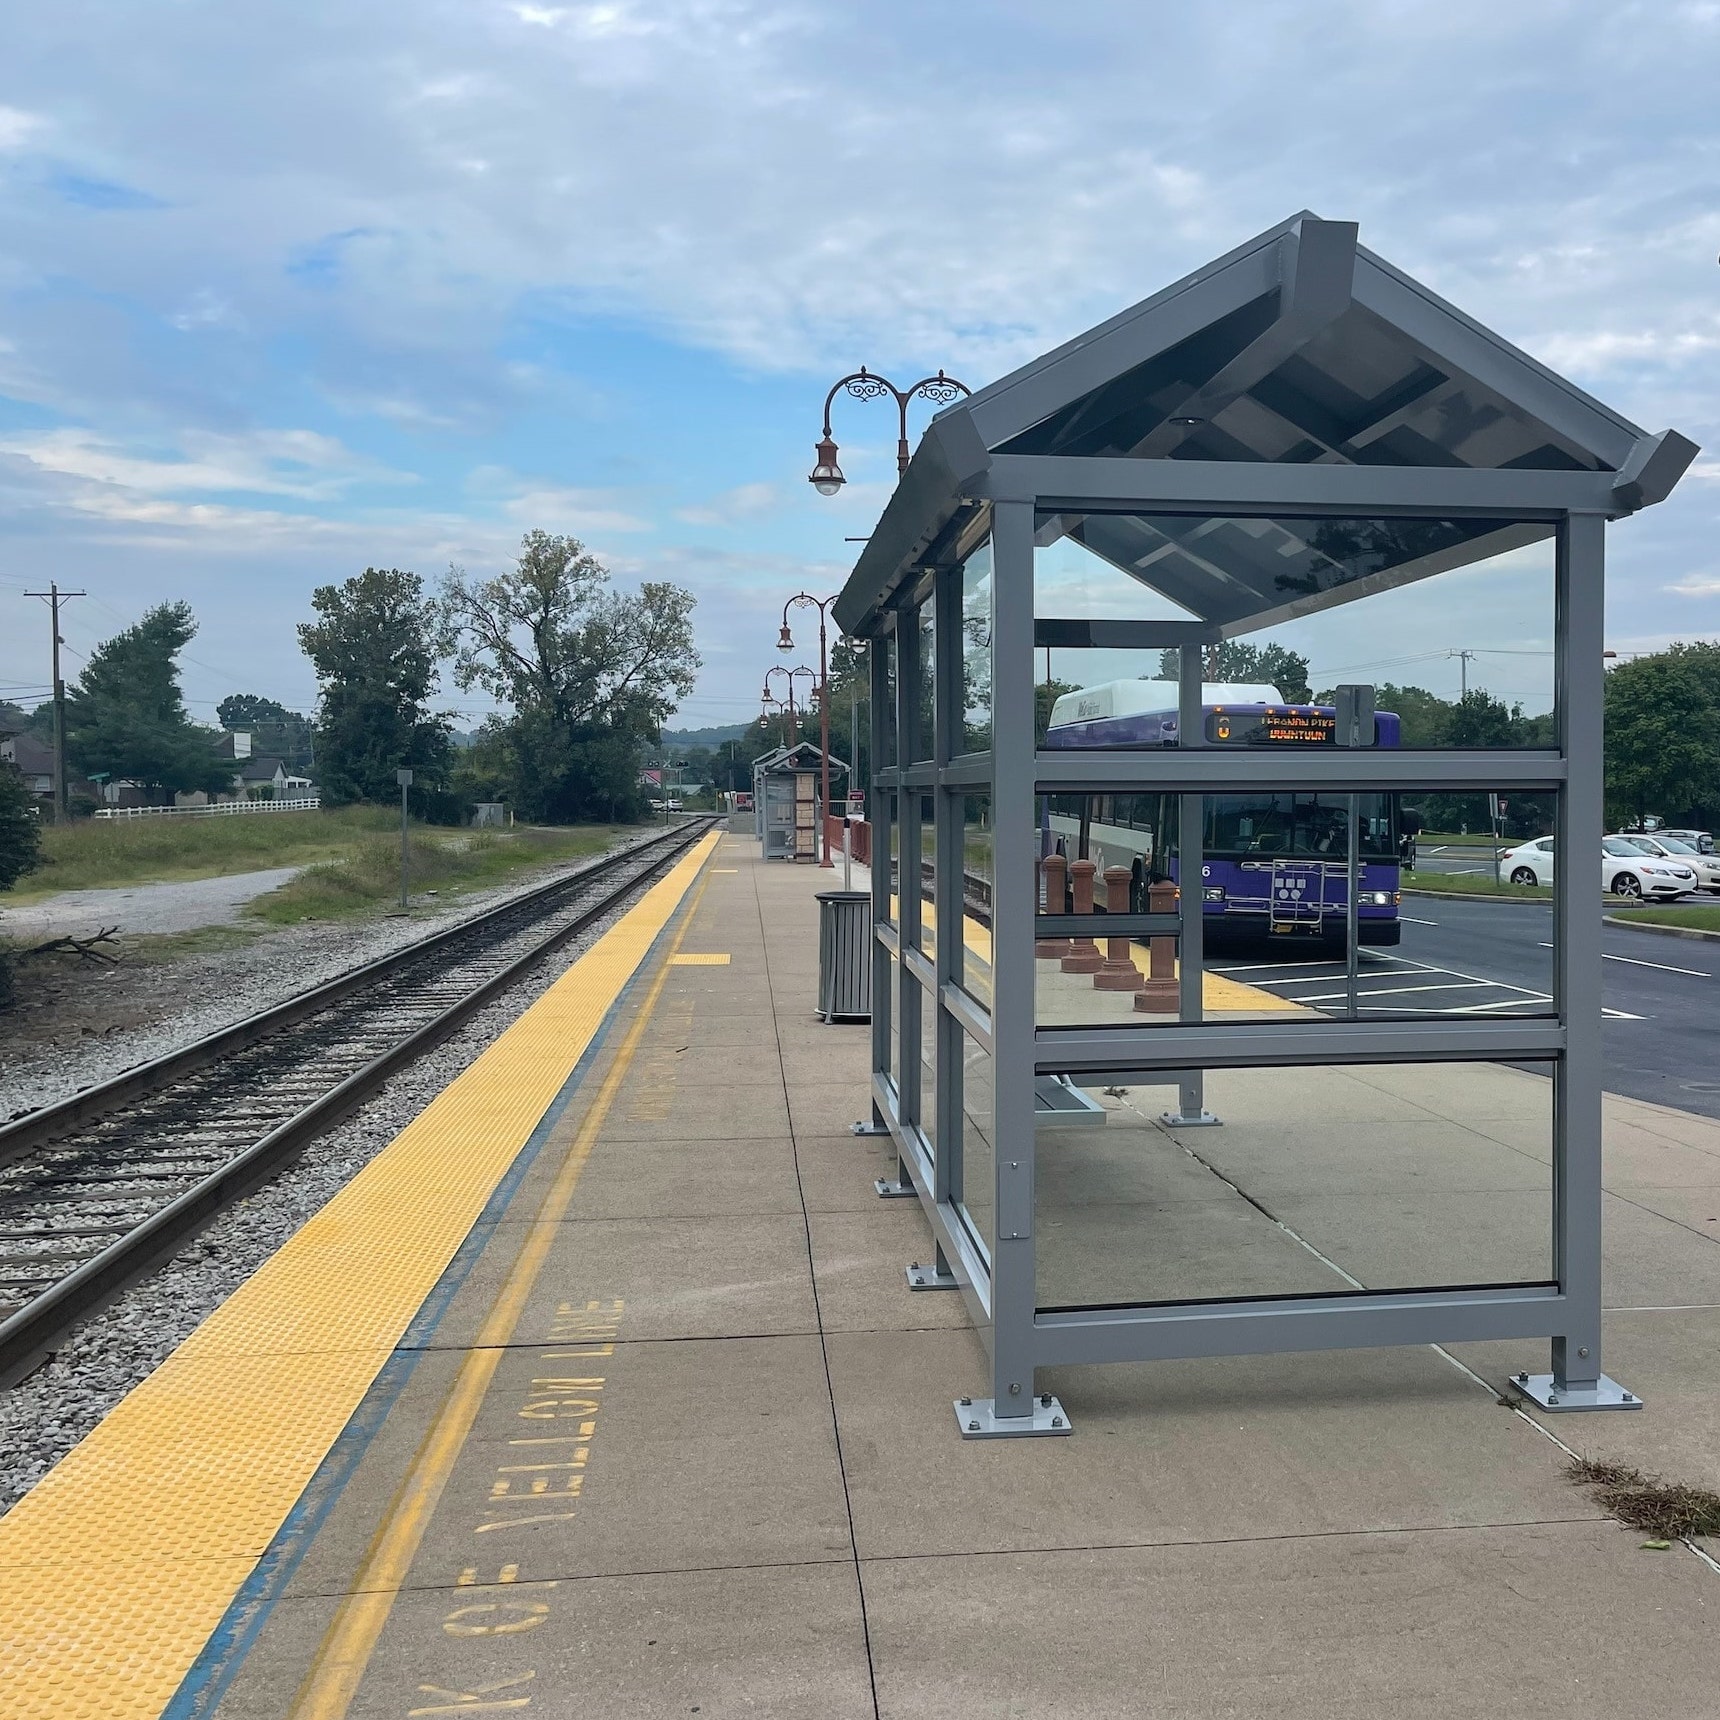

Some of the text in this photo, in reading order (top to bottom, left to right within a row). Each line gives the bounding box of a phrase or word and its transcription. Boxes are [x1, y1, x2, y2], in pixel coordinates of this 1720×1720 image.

[540, 1299, 624, 1358] LINE
[474, 1376, 606, 1534] YELLOW
[442, 1563, 558, 1638] OF
